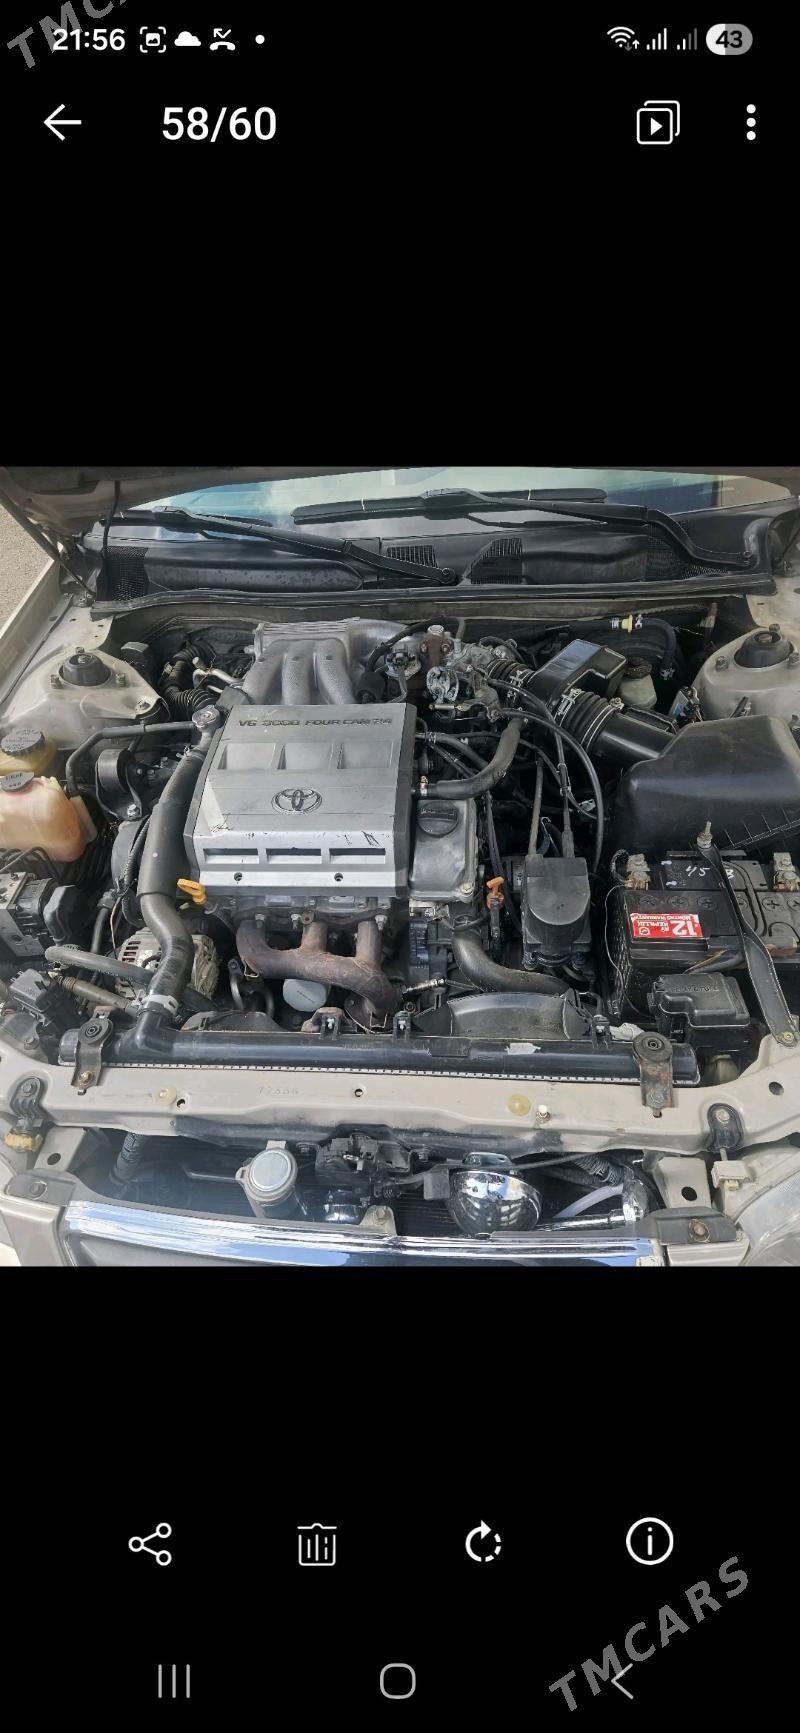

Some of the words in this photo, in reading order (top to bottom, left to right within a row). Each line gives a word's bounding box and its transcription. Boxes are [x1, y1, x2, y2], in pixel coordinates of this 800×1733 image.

[52, 28, 126, 50] 21:56
[715, 30, 743, 49] 43
[162, 106, 277, 142] 58/60
[305, 718, 341, 726] FOUR
[670, 920, 697, 936] 12
